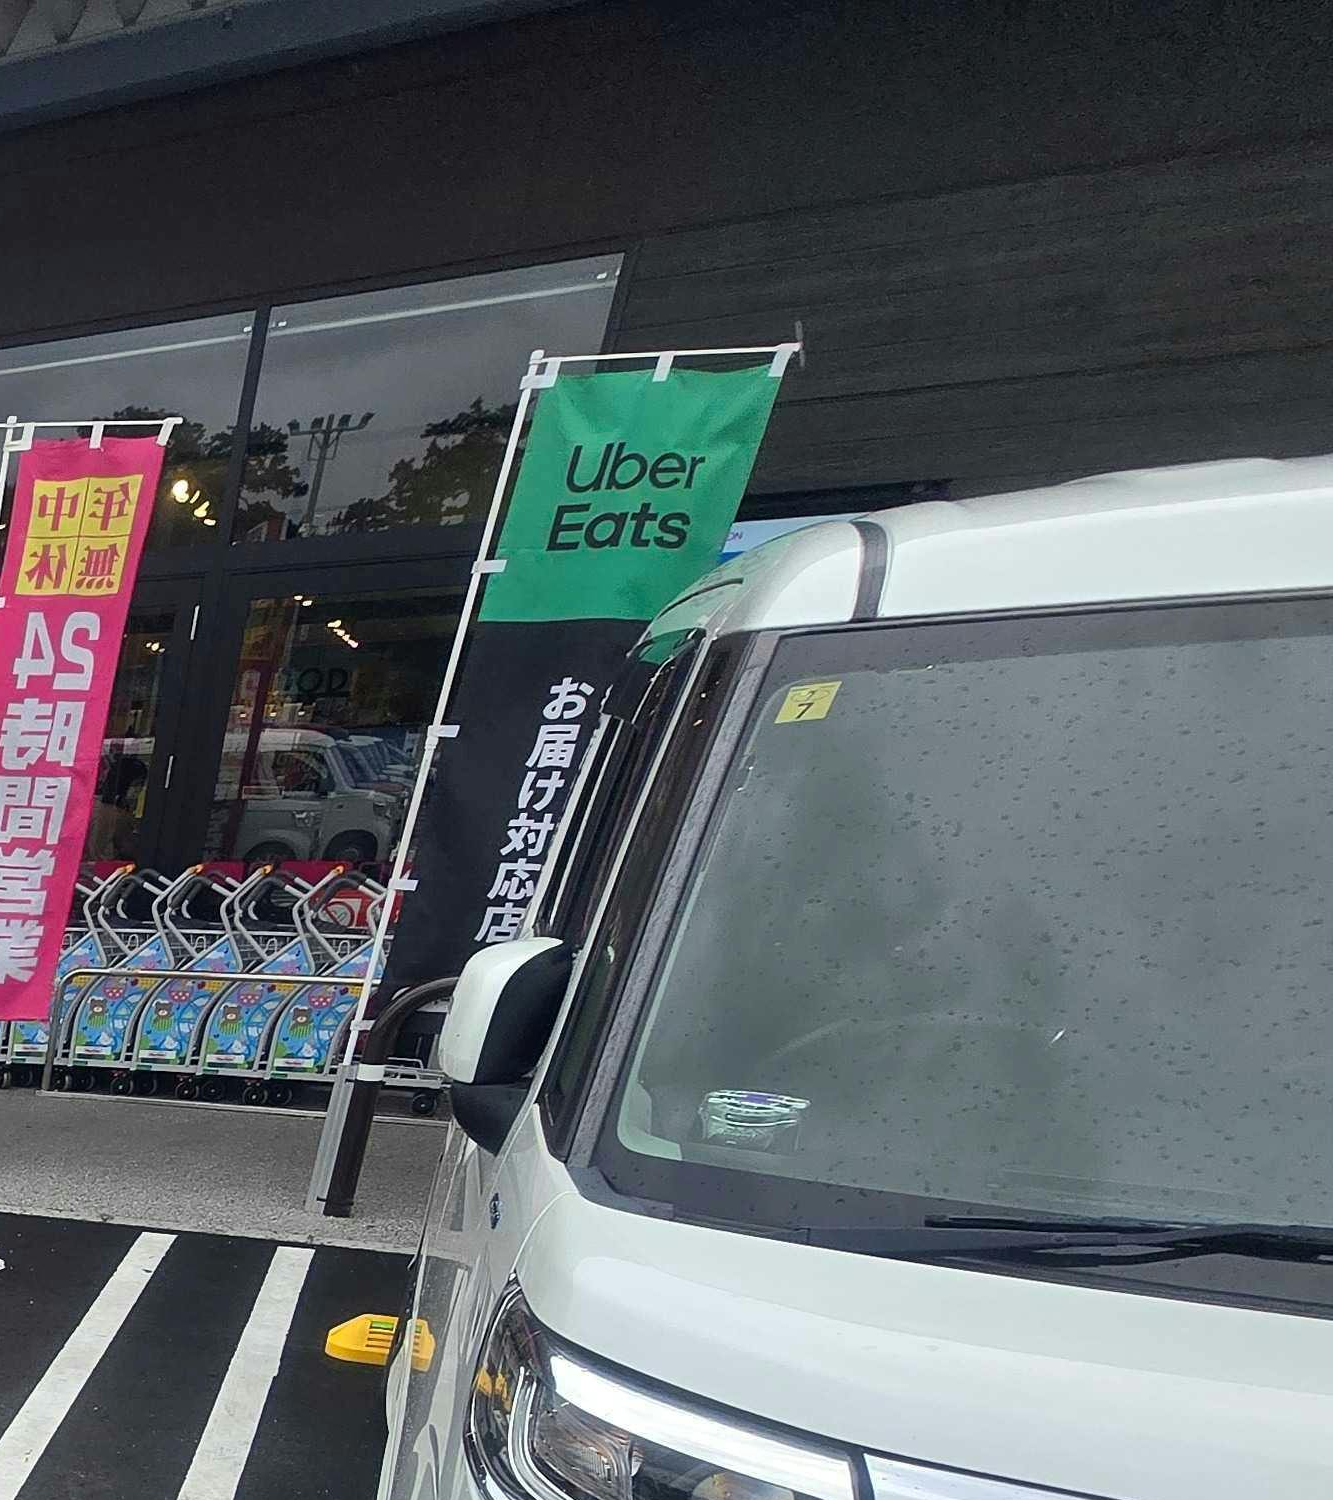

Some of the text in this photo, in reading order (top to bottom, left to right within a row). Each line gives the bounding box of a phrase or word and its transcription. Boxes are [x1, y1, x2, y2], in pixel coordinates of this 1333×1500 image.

[565, 441, 707, 494] Uber
[545, 501, 692, 552] Eats
[795, 702, 814, 719] 7
[473, 676, 595, 944] お届け対応店
